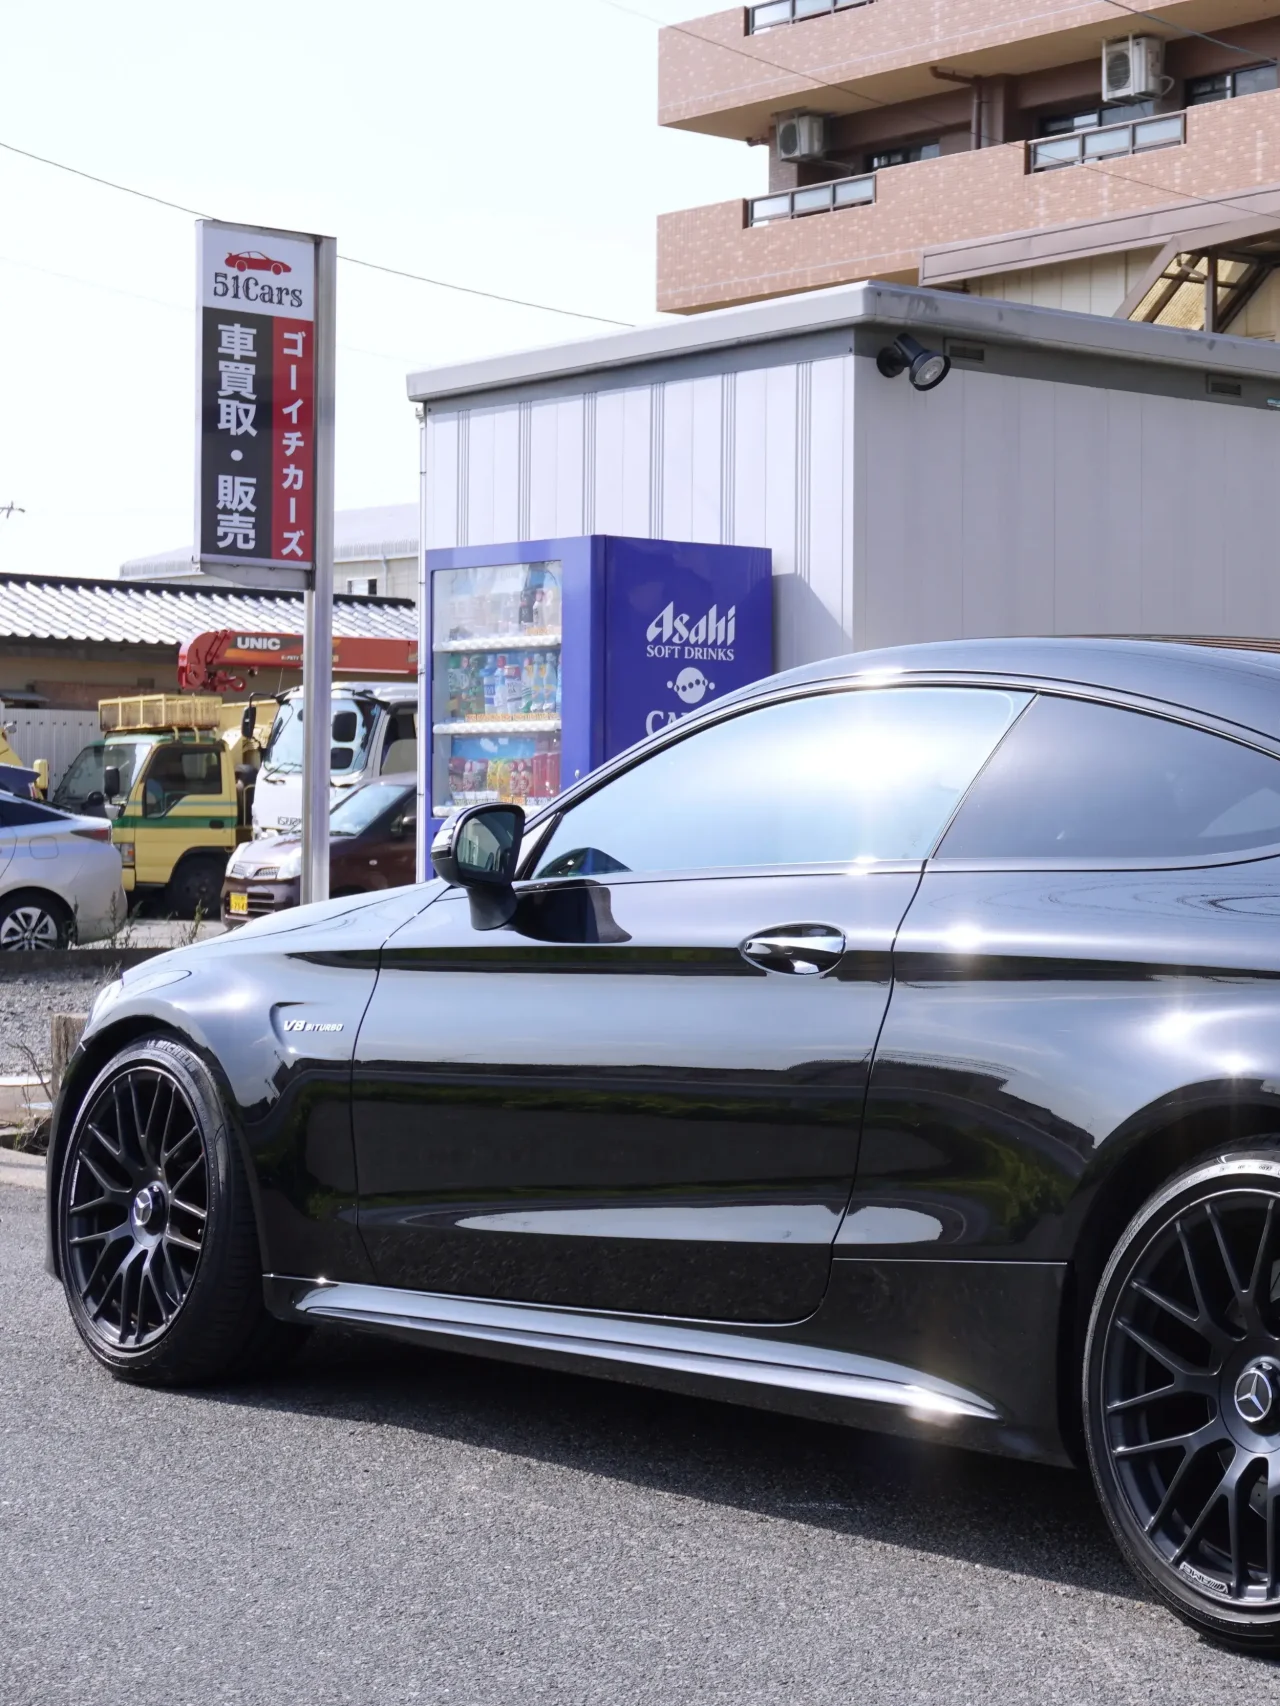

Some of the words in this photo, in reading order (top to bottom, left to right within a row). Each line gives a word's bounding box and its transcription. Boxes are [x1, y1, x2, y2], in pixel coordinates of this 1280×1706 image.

[213, 272, 303, 308] 51Cars
[216, 323, 258, 550] 車買取・販売
[281, 331, 306, 557] ゴーイチカーズ
[646, 601, 736, 646] Asahi
[236, 637, 281, 650] UNIC
[646, 644, 681, 659] SOFT
[684, 646, 735, 662] DRINKS
[283, 1020, 307, 1031] V8
[305, 1023, 344, 1031] BITURBO
